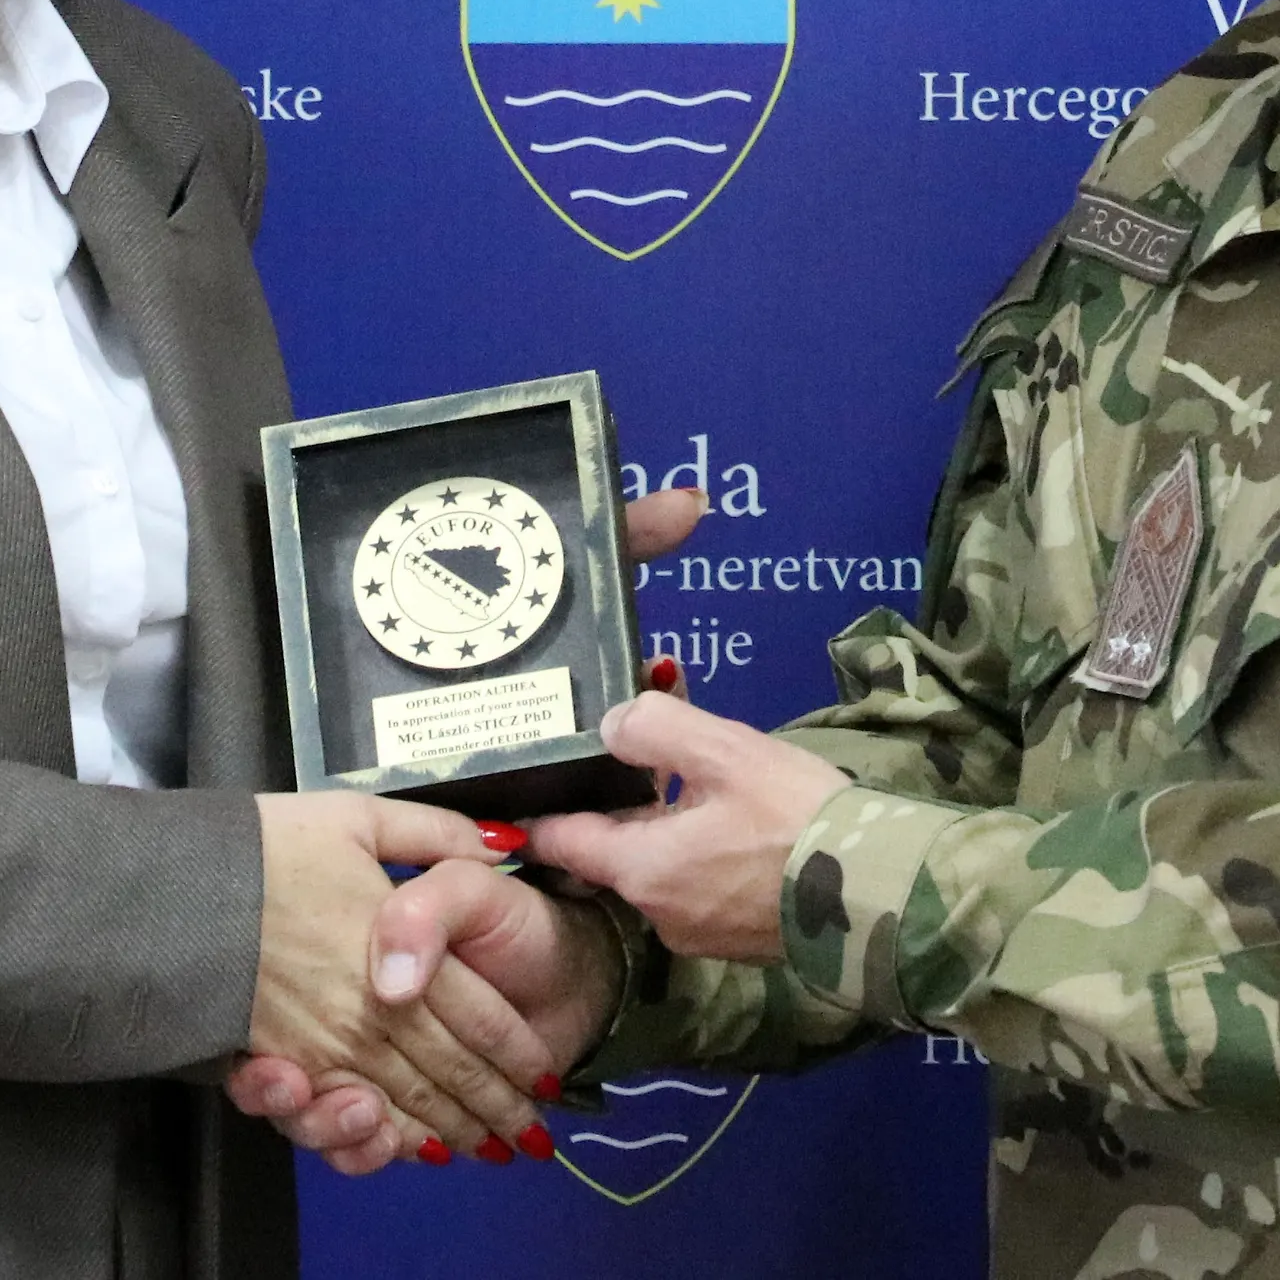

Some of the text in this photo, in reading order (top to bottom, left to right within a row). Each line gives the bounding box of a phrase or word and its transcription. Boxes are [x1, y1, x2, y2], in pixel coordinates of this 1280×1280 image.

[620, 434, 768, 518] ada
[416, 517, 493, 546] EUFOR
[388, 693, 559, 729] In appreciation of your support
[406, 681, 537, 710] OPERATION ALTHEA
[398, 710, 553, 746] MG László STICZ PhD
[412, 729, 542, 759] Commander of EUFOR
